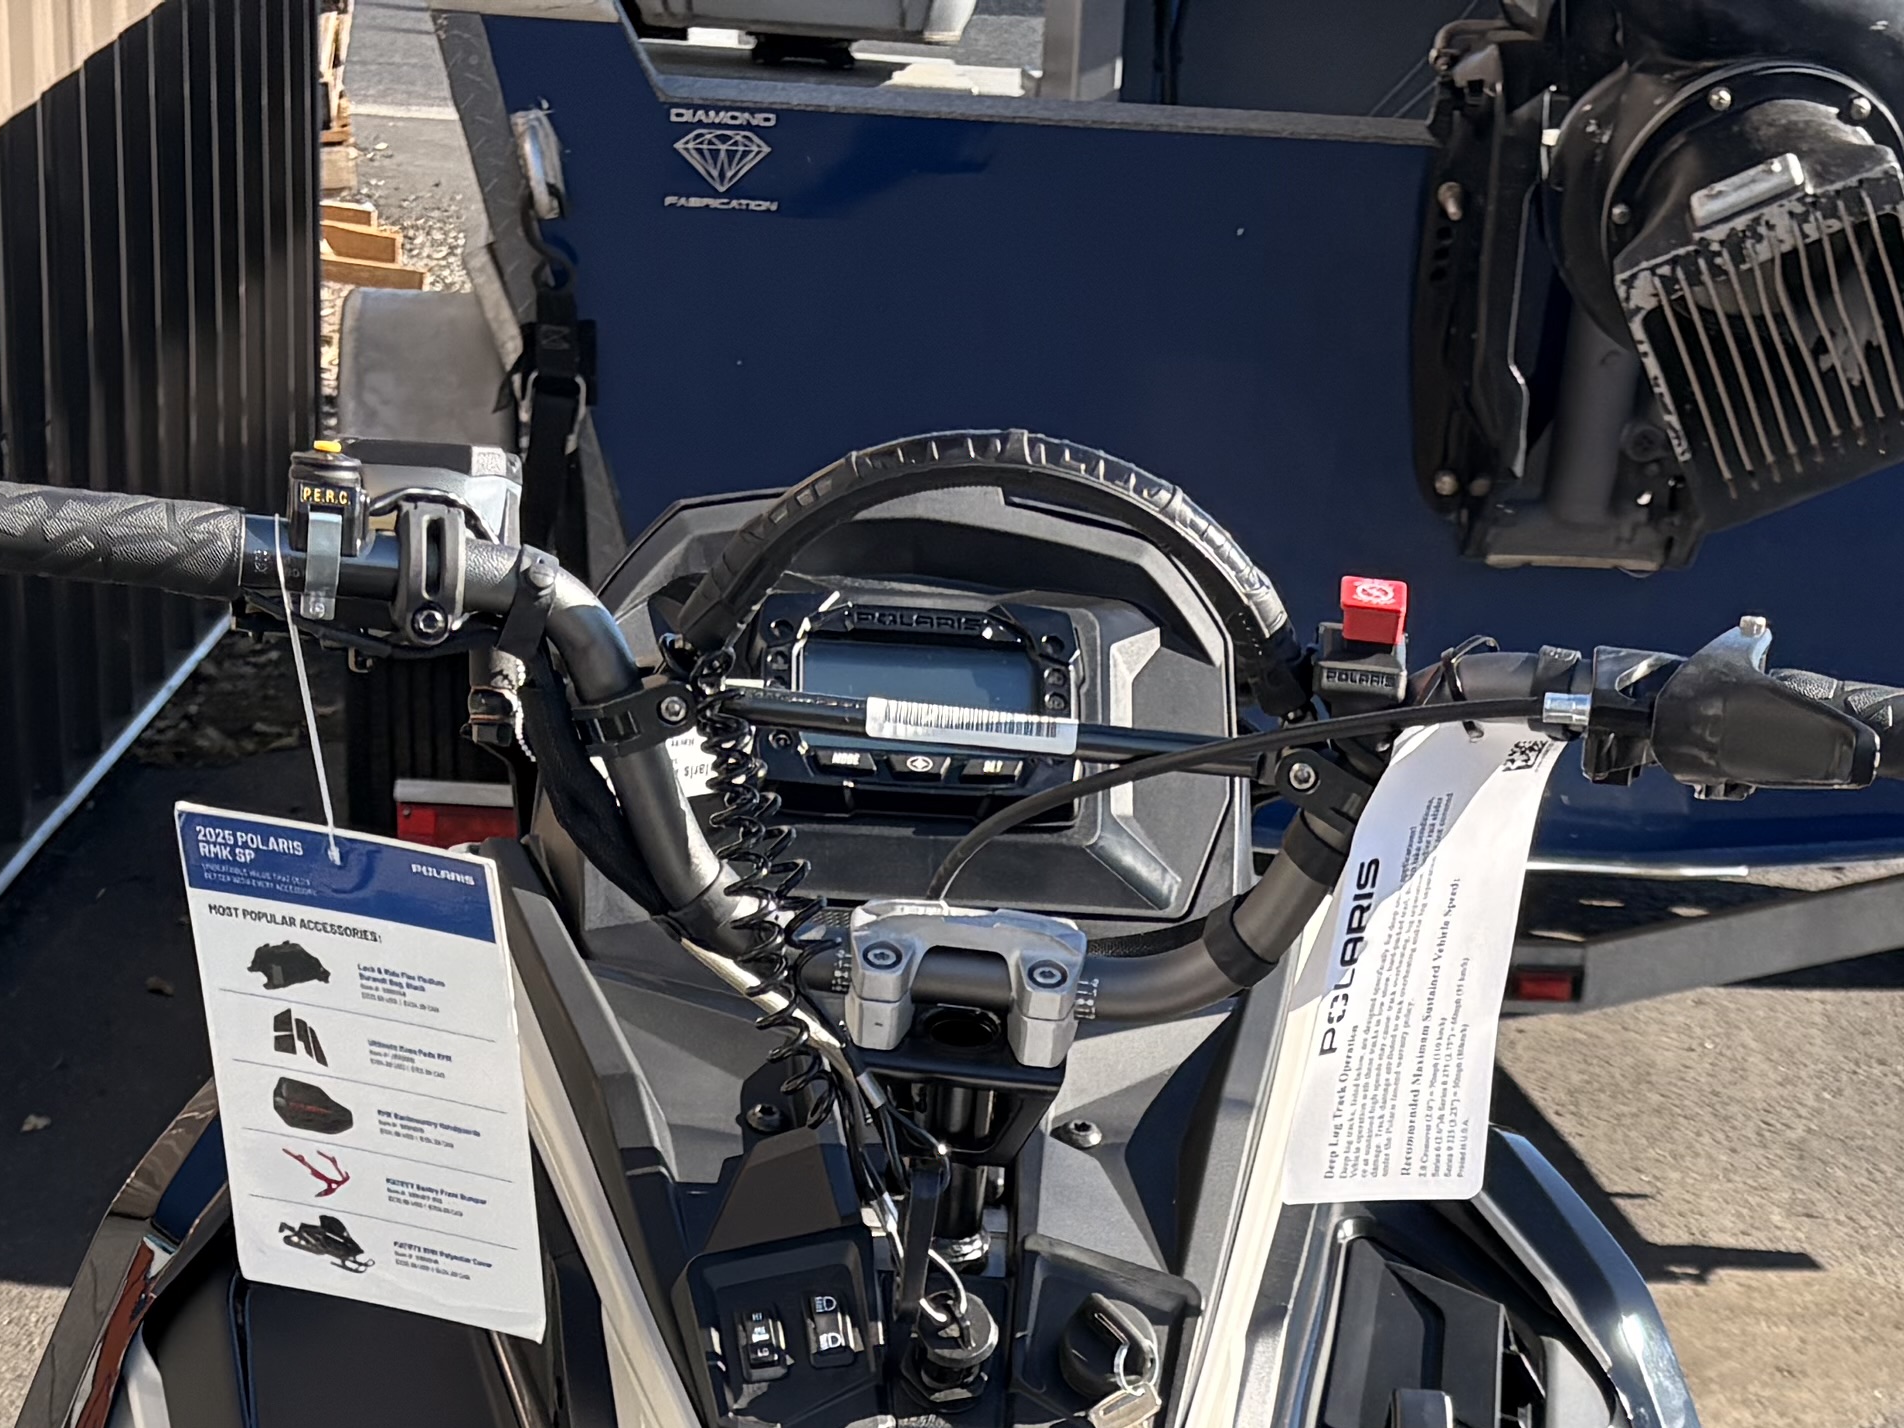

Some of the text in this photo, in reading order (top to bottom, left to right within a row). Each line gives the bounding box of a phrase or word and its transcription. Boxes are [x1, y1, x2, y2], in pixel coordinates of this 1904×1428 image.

[669, 108, 777, 127] DIAMOND
[664, 196, 779, 211] FABRICATION
[302, 486, 351, 505] P.E.R.C.
[855, 610, 984, 632] POLARIS
[1326, 669, 1397, 688] POLARIS
[196, 825, 304, 856] 2025 POLARIS
[199, 842, 256, 864] RMK SP
[411, 862, 476, 886] POLARIS
[208, 903, 383, 944] MOST POPULAR ACCESSORIES:
[1319, 857, 1381, 1057] POLARIS
[1400, 1089, 1421, 1176] Recommended
[1411, 1025, 1430, 1085] Maximum
[1422, 965, 1441, 1022] Sustained
[1432, 920, 1450, 962] Vehicle
[1323, 1025, 1359, 1179] Deep Lug Track Operation
